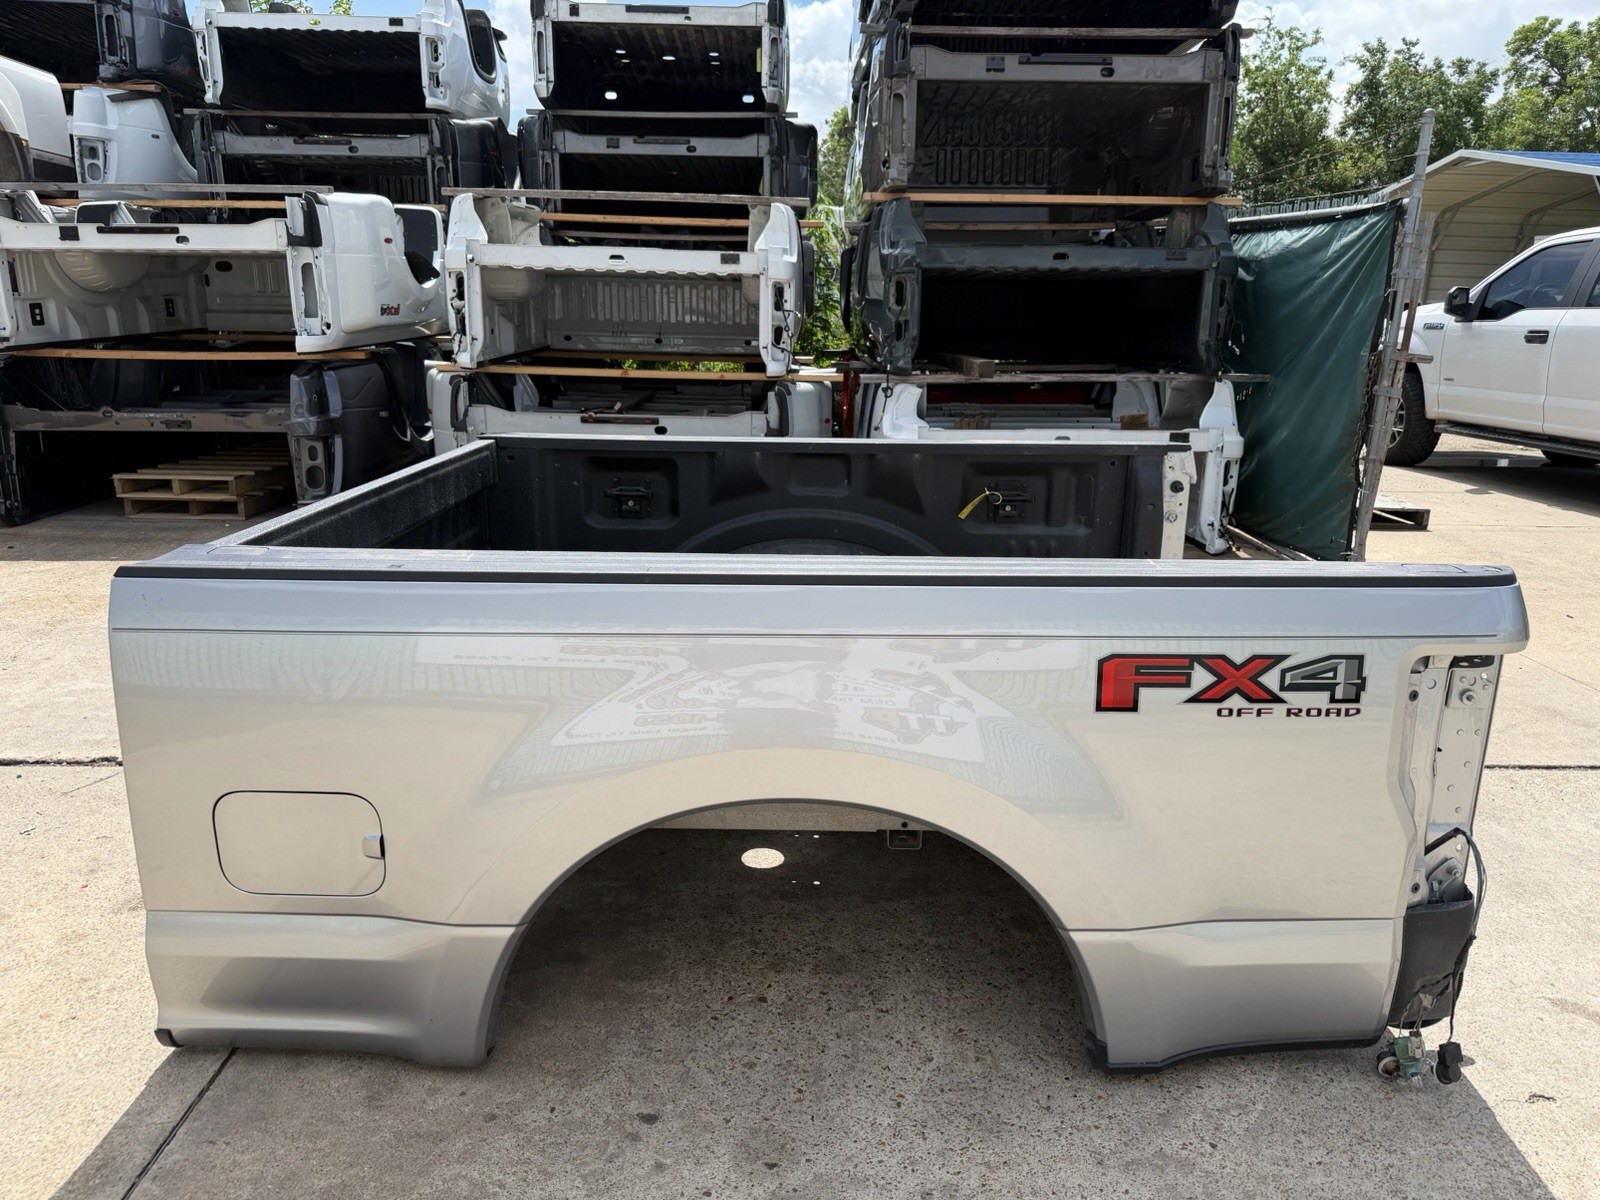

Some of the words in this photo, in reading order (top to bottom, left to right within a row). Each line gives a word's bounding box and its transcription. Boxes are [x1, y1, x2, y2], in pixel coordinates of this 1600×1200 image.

[1095, 653, 1366, 712] FX4
[1216, 707, 1273, 717] OFF
[1286, 707, 1361, 717] ROAD
